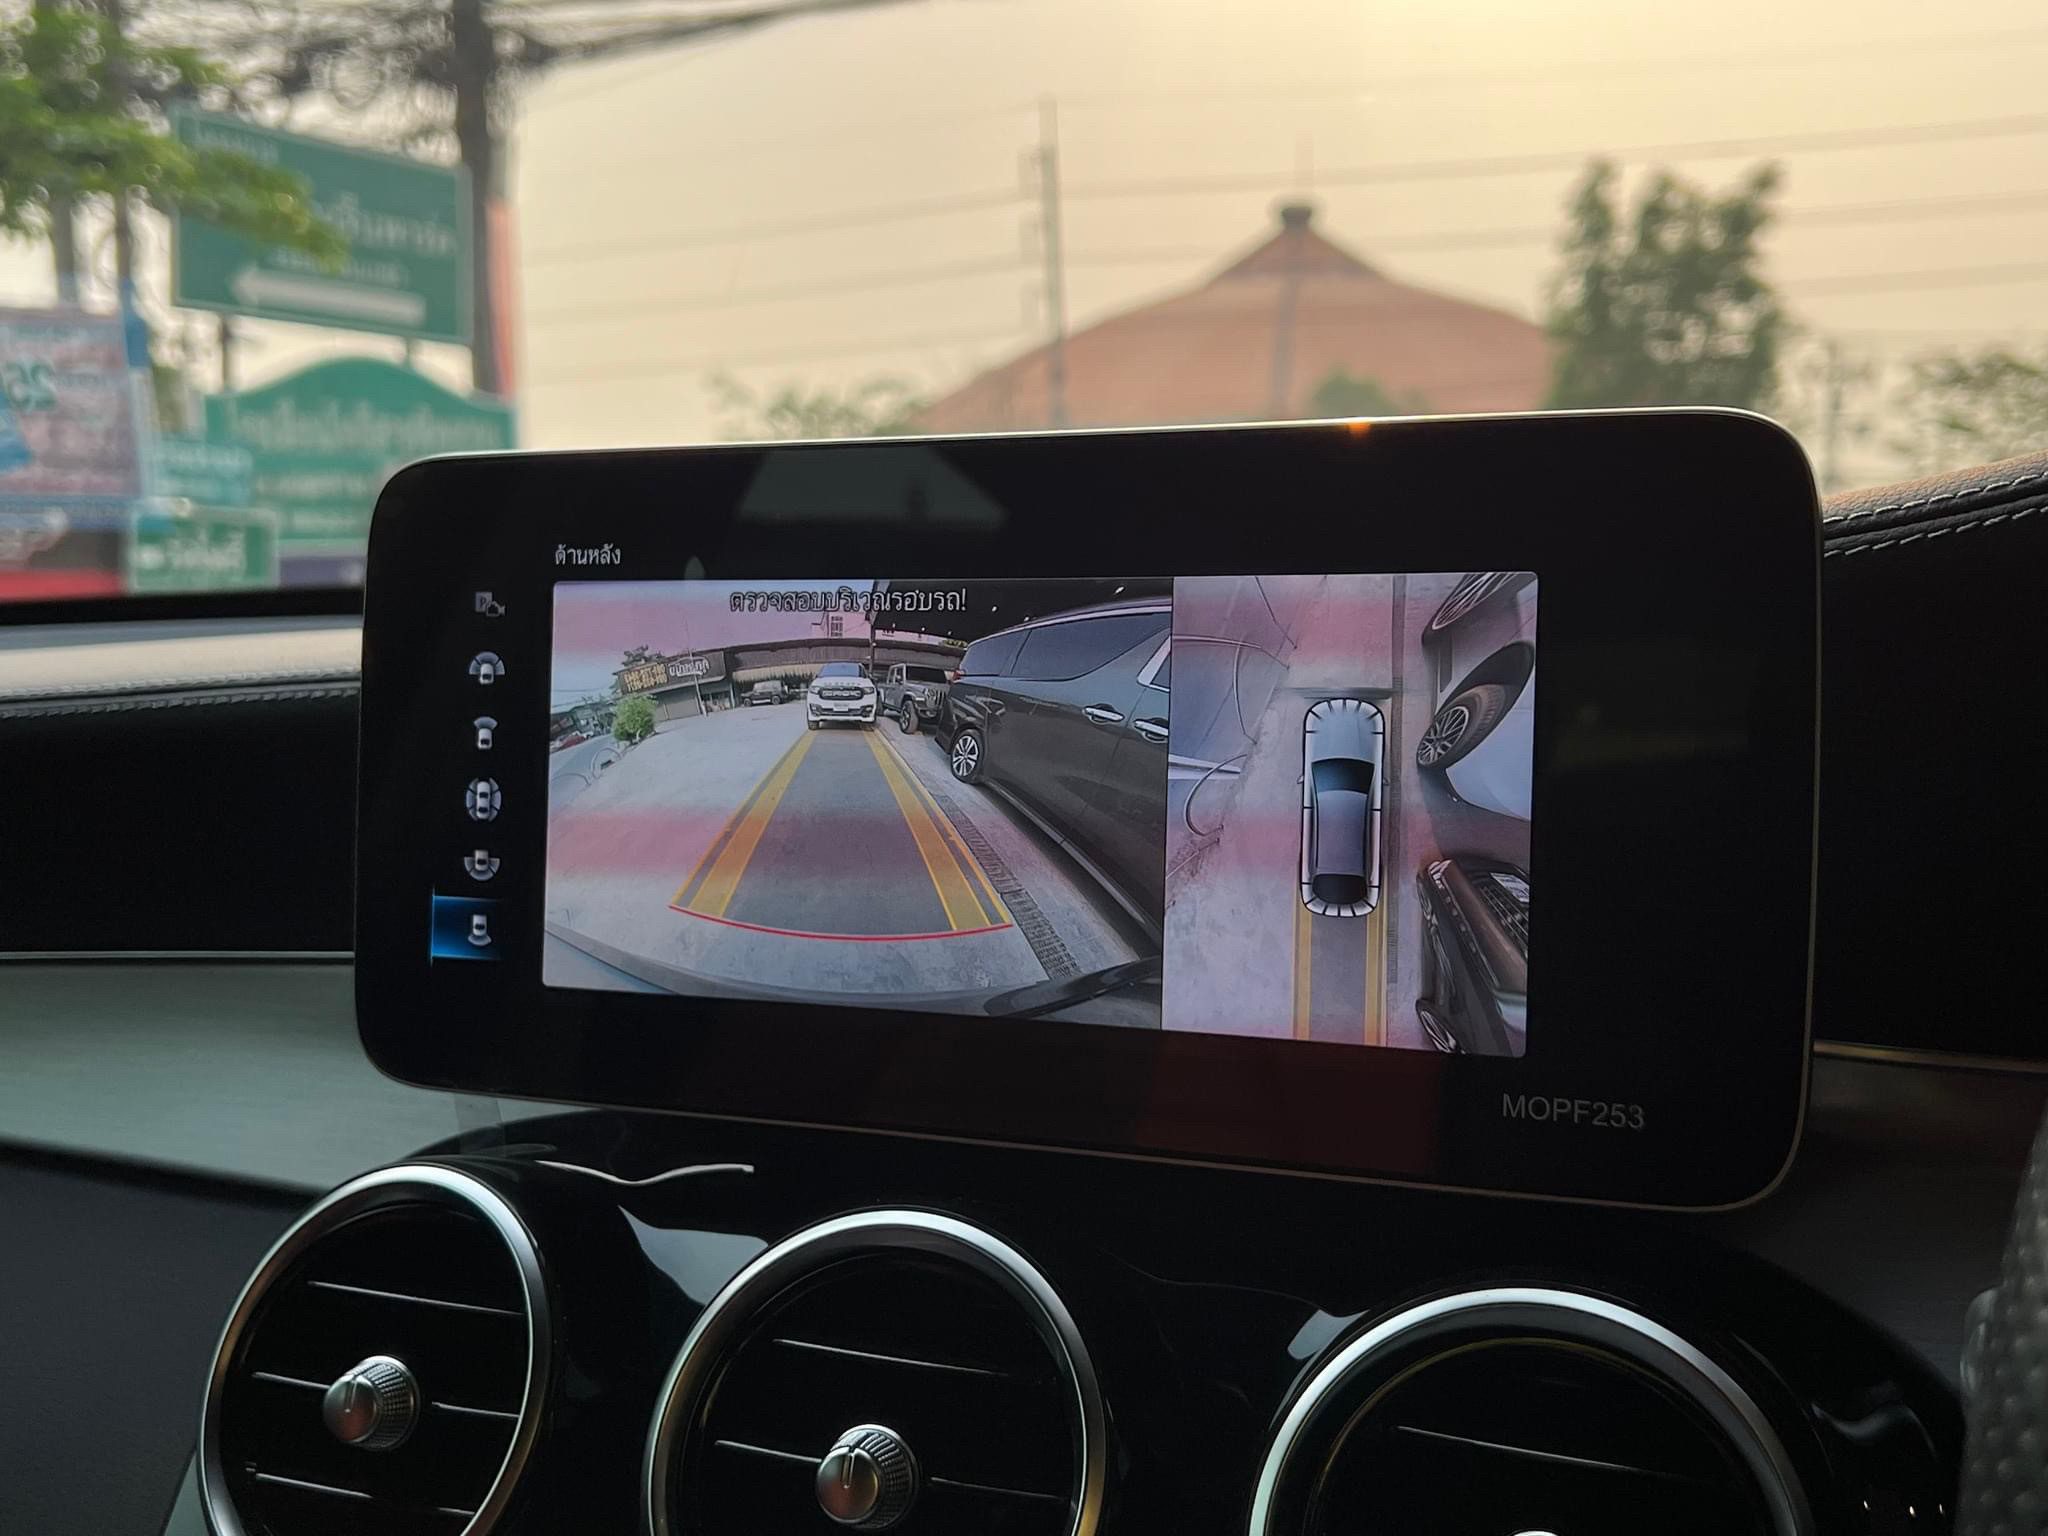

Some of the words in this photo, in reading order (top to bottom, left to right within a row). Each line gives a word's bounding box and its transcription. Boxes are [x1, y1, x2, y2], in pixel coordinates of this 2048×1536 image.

[555, 543, 621, 565] ด้านหลัง
[730, 586, 968, 612] ตรวจสอบบริเวณรอบรถ!
[1502, 1093, 1646, 1129] MOPF253
